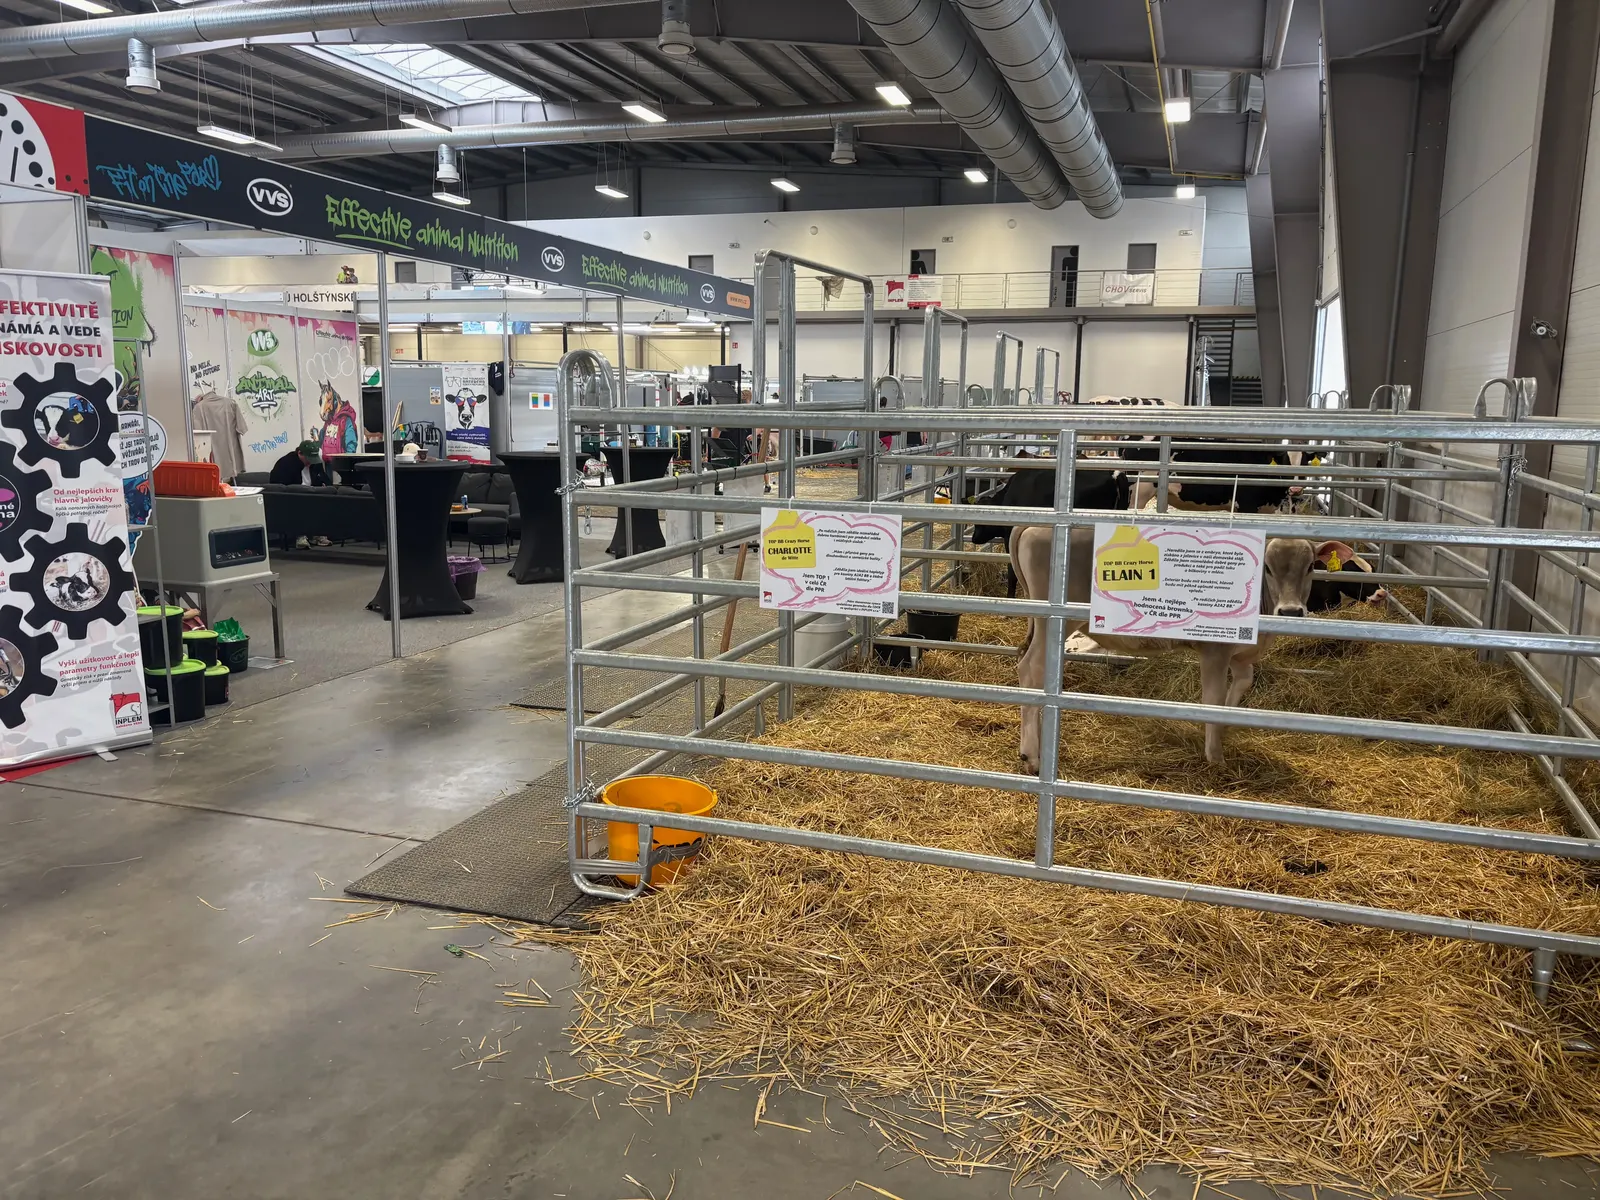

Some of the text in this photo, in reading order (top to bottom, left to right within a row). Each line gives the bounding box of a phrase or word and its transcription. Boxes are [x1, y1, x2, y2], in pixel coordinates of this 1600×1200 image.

[252, 187, 288, 208] VVS
[325, 194, 412, 241] Effective
[416, 218, 464, 253] animal
[544, 252, 562, 266] VVS
[582, 254, 627, 283] Effective
[629, 268, 656, 291] animal
[702, 288, 714, 300] VVS
[49, 325, 60, 335] A
[64, 326, 101, 337] VEDE
[190, 364, 197, 373] NO
[236, 371, 297, 395] ANIMAL
[255, 388, 274, 401] ART
[66, 488, 104, 496] nejlepších
[81, 496, 112, 504] jalovičky
[768, 547, 812, 555] CHARLOTTE
[1103, 568, 1155, 581] ELAIN 1
[1134, 602, 1193, 613] hodnocená brownka
[79, 654, 116, 665] užitkovost
[59, 659, 136, 677] parametry funkčnosti
[116, 716, 142, 725] INPLEM
